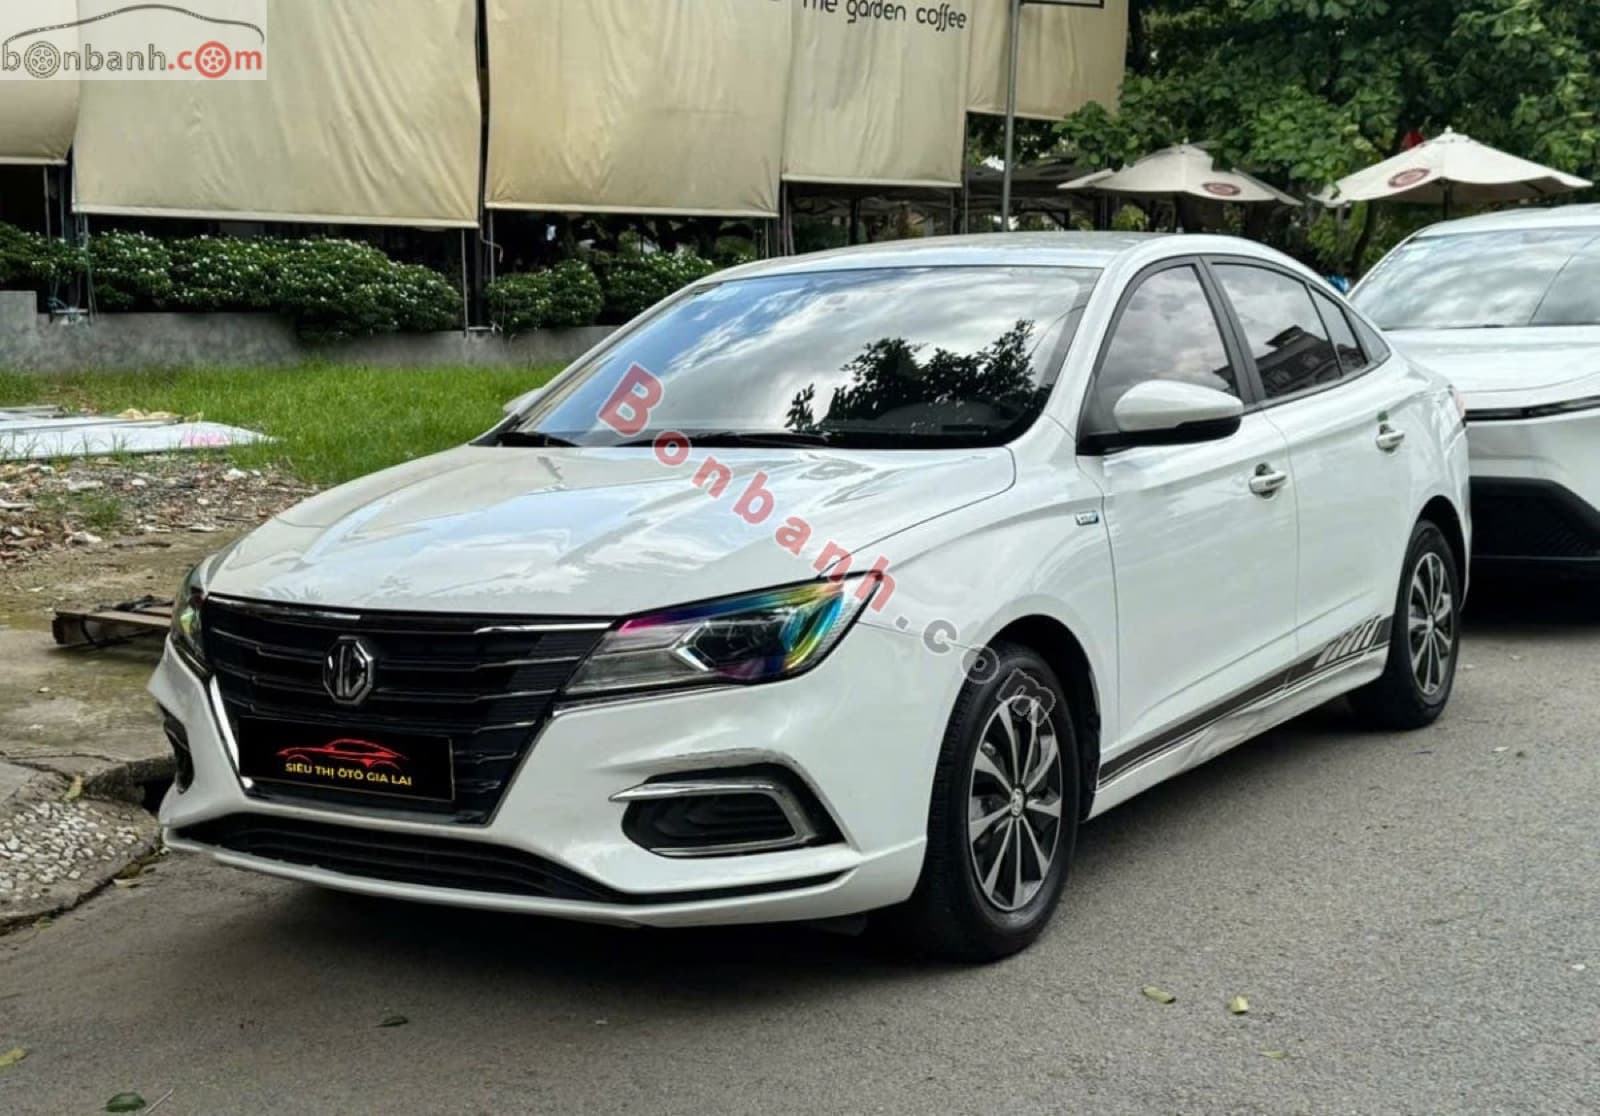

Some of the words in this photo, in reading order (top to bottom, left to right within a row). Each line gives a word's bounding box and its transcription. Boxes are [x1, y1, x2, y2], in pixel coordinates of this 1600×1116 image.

[846, 0, 906, 24] garden
[916, 3, 967, 32] coffee
[366, 771, 389, 783] GIA
[391, 775, 412, 786] LAI
